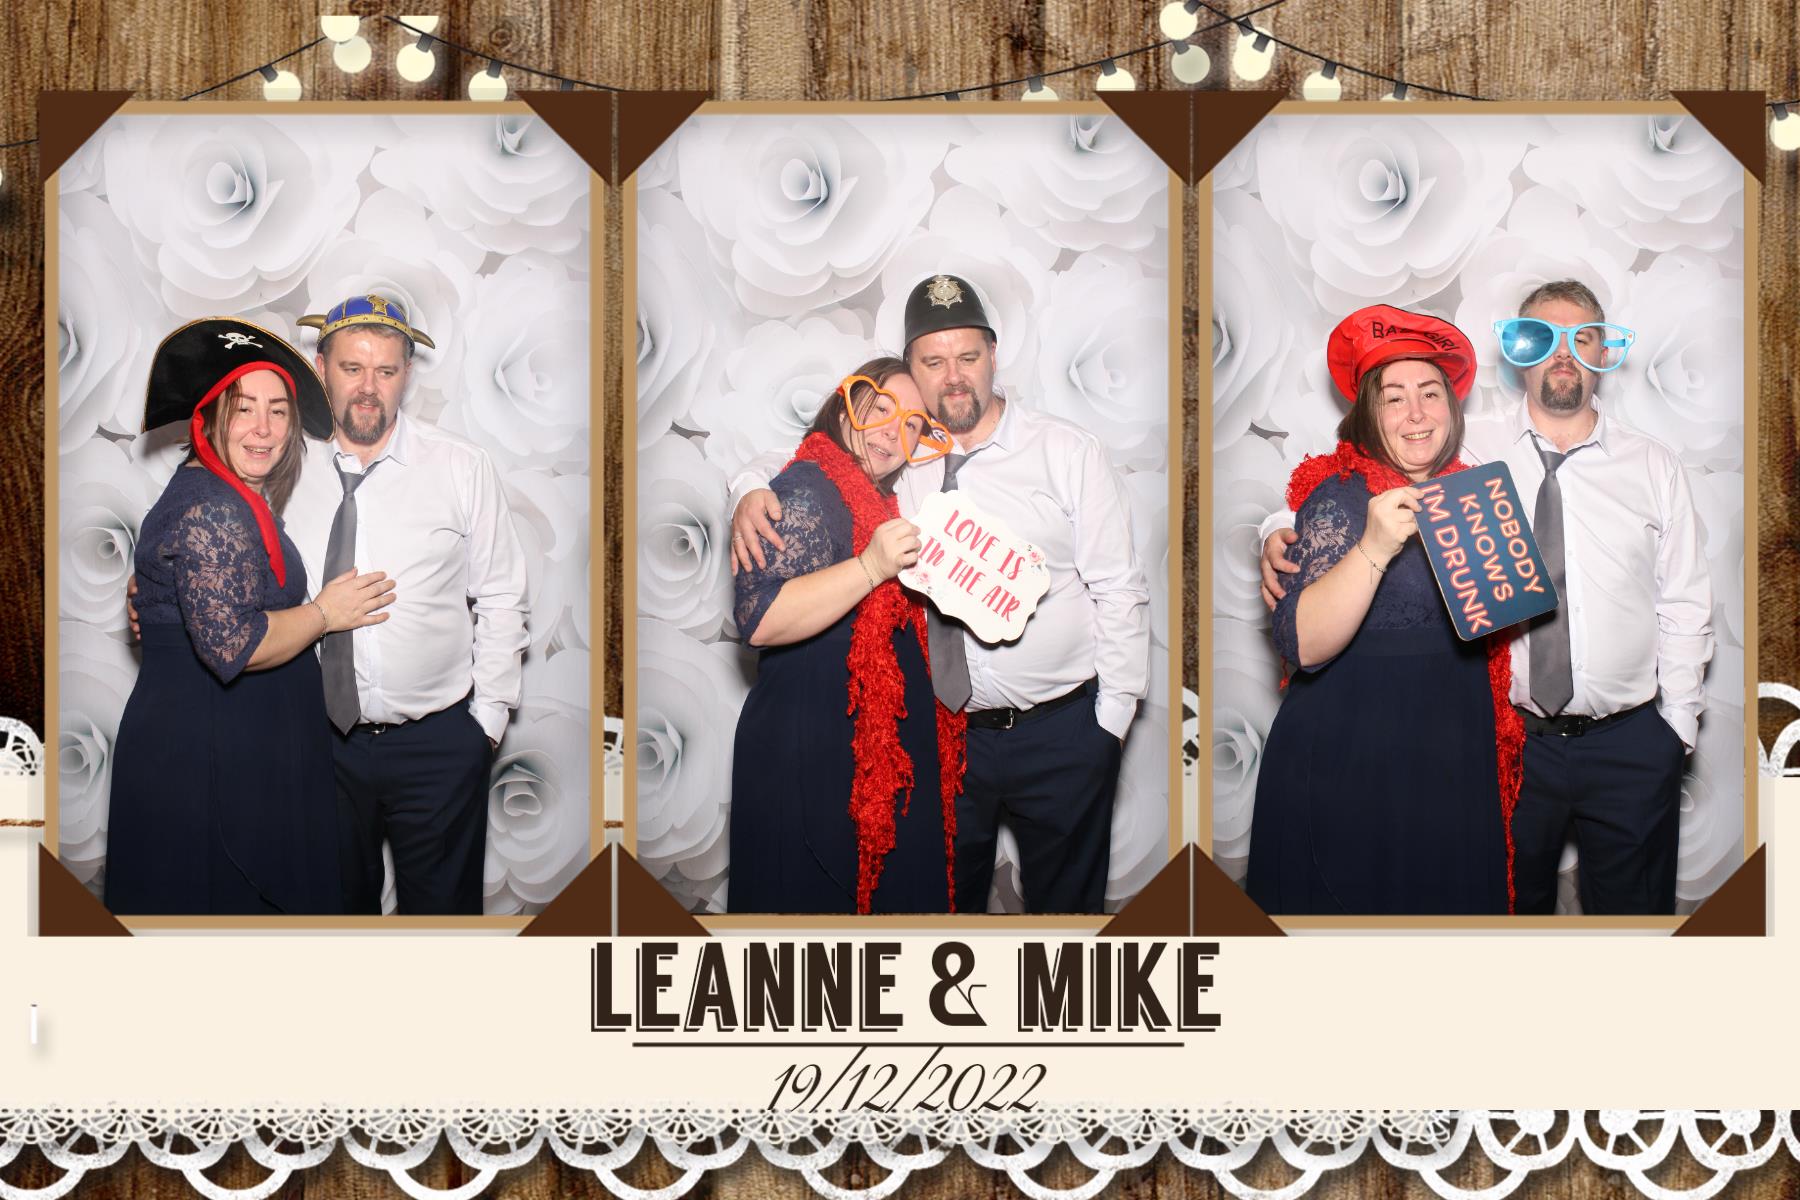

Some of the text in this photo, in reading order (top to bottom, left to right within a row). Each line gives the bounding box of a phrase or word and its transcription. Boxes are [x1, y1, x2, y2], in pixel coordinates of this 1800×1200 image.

[1423, 331, 1461, 351] GIRL
[944, 509, 1026, 581] LOVE IS
[1419, 483, 1493, 634] I'M DRUNK
[1458, 493, 1515, 602] KNOWS
[1484, 477, 1545, 594] NOBODY
[947, 556, 986, 595] THE
[981, 585, 1021, 622] AIR
